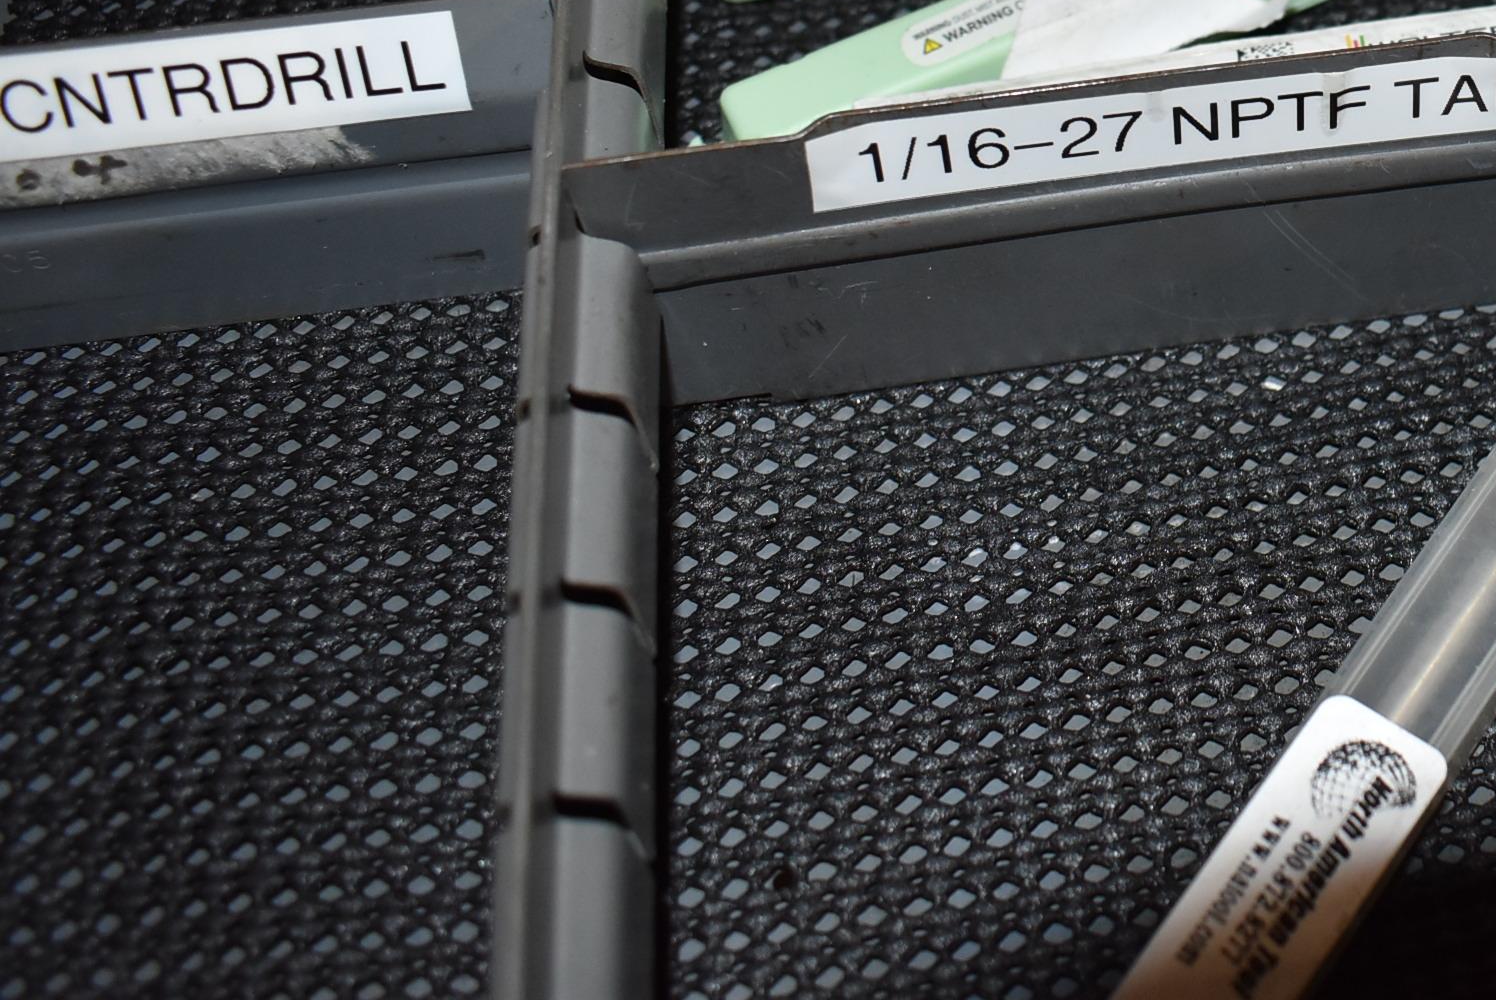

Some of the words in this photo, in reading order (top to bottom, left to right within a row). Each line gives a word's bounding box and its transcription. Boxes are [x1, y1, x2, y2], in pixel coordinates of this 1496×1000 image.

[943, 6, 1014, 42] WARNING
[0, 40, 447, 135] CNTRDRILL
[1172, 86, 1372, 147] NPTF
[1341, 776, 1393, 841] North
[1268, 833, 1351, 949] American
